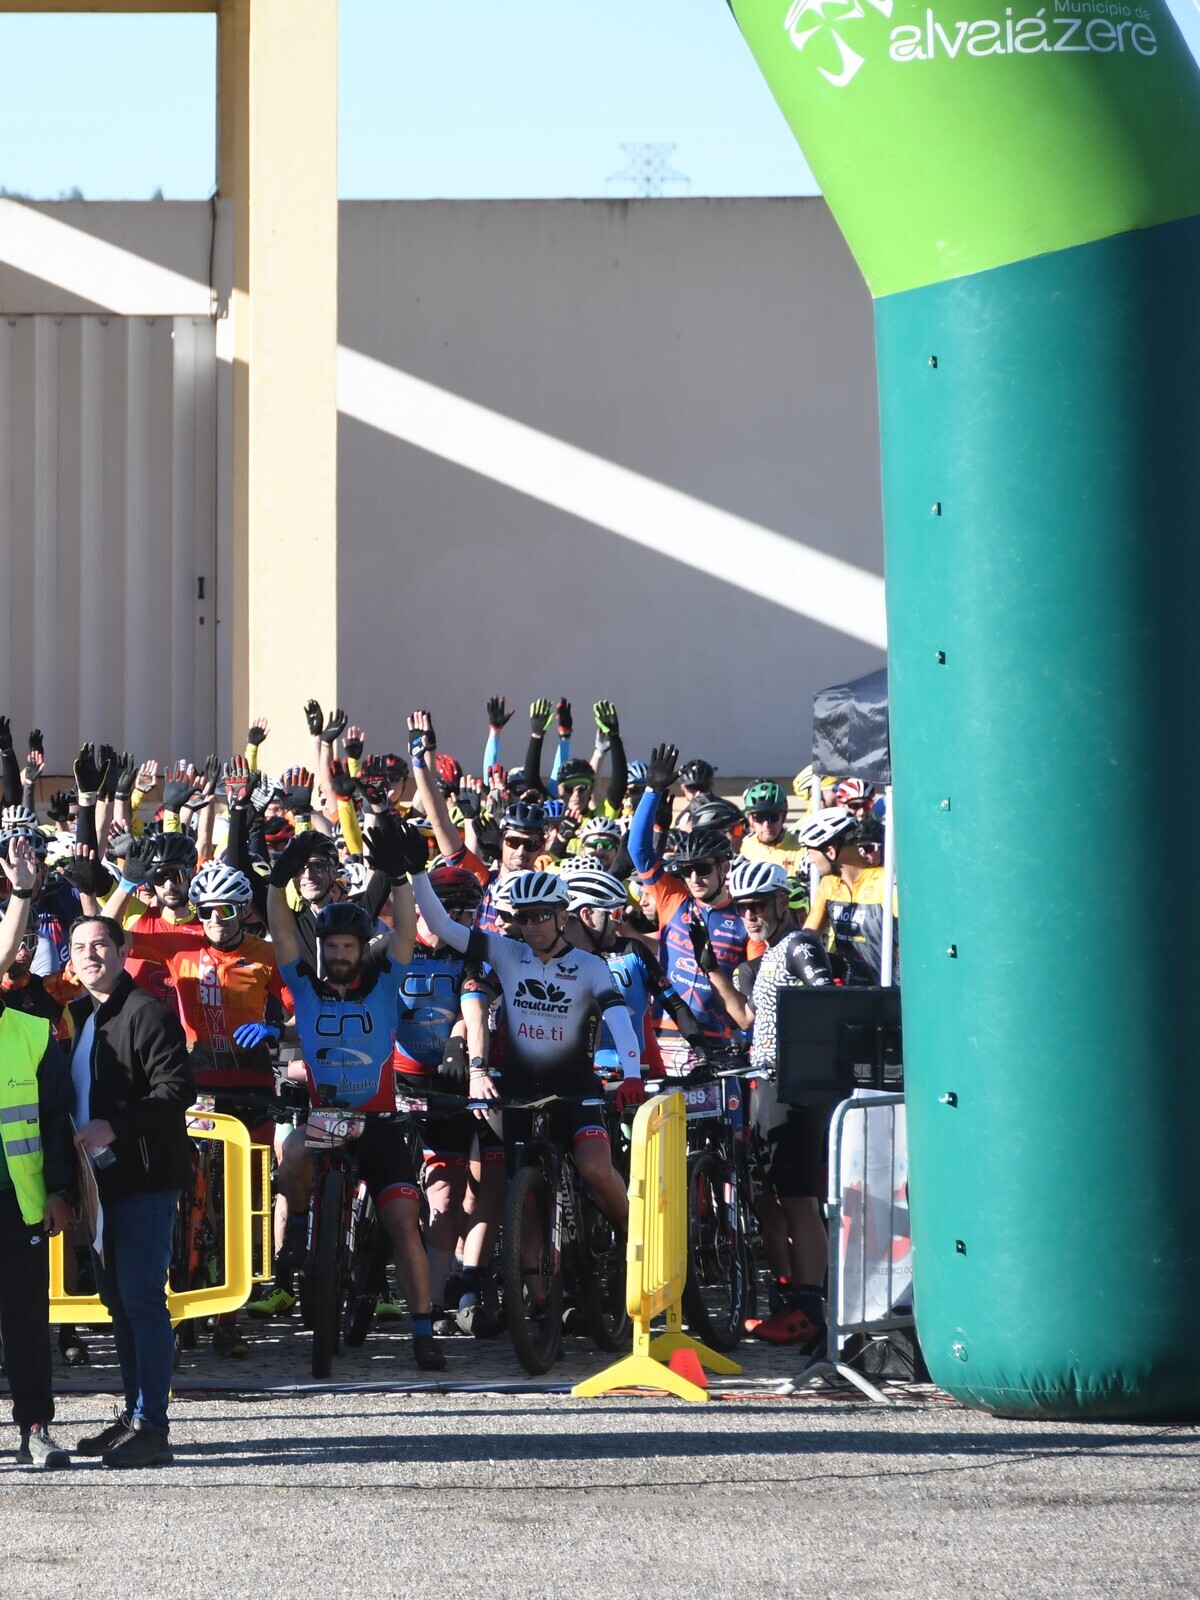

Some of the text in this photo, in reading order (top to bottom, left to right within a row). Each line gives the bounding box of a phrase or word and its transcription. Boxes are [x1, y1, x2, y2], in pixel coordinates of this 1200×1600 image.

[1135, 8, 1151, 20] de
[889, 7, 1158, 62] alvaiázere
[513, 998, 569, 1014] neutura
